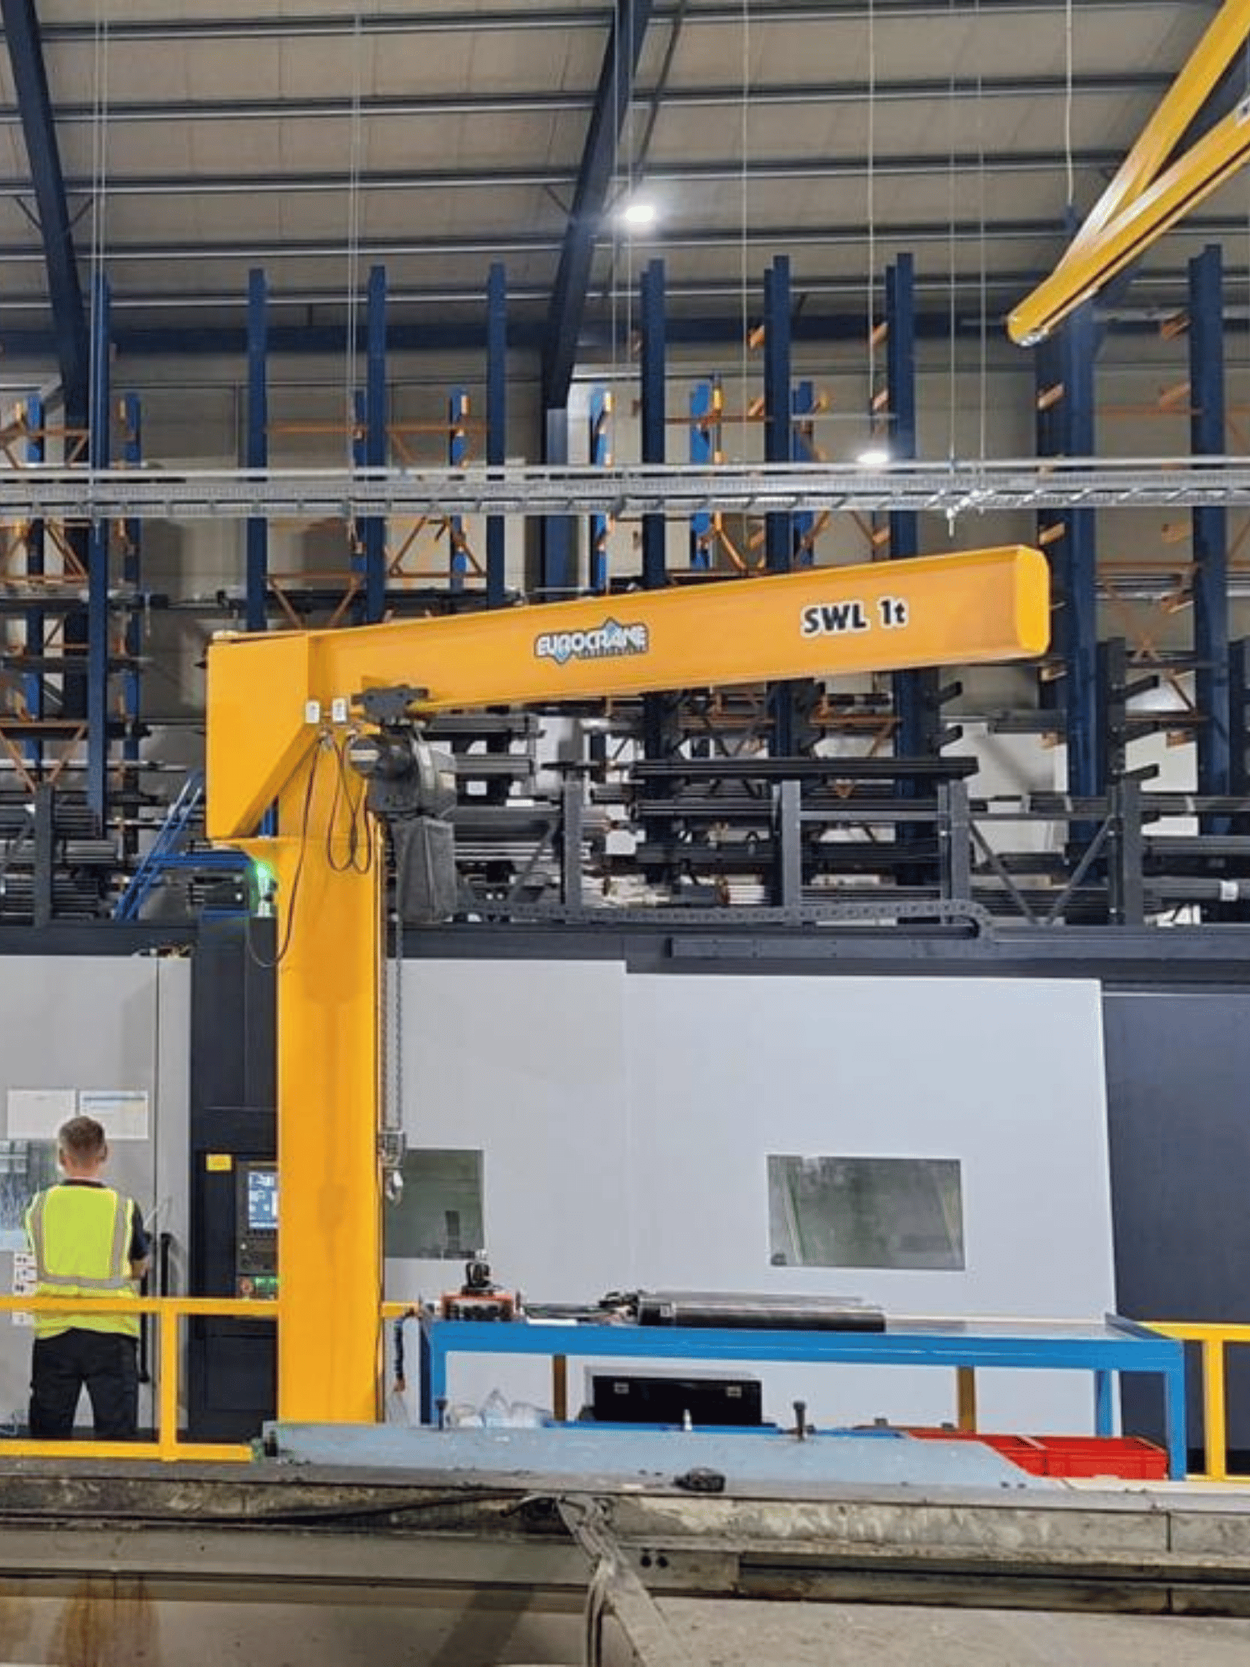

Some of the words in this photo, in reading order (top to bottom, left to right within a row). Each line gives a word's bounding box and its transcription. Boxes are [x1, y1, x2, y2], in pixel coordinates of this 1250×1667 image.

[803, 603, 867, 633] SWL
[880, 600, 906, 624] 1t
[536, 623, 647, 657] EUROCRANE
